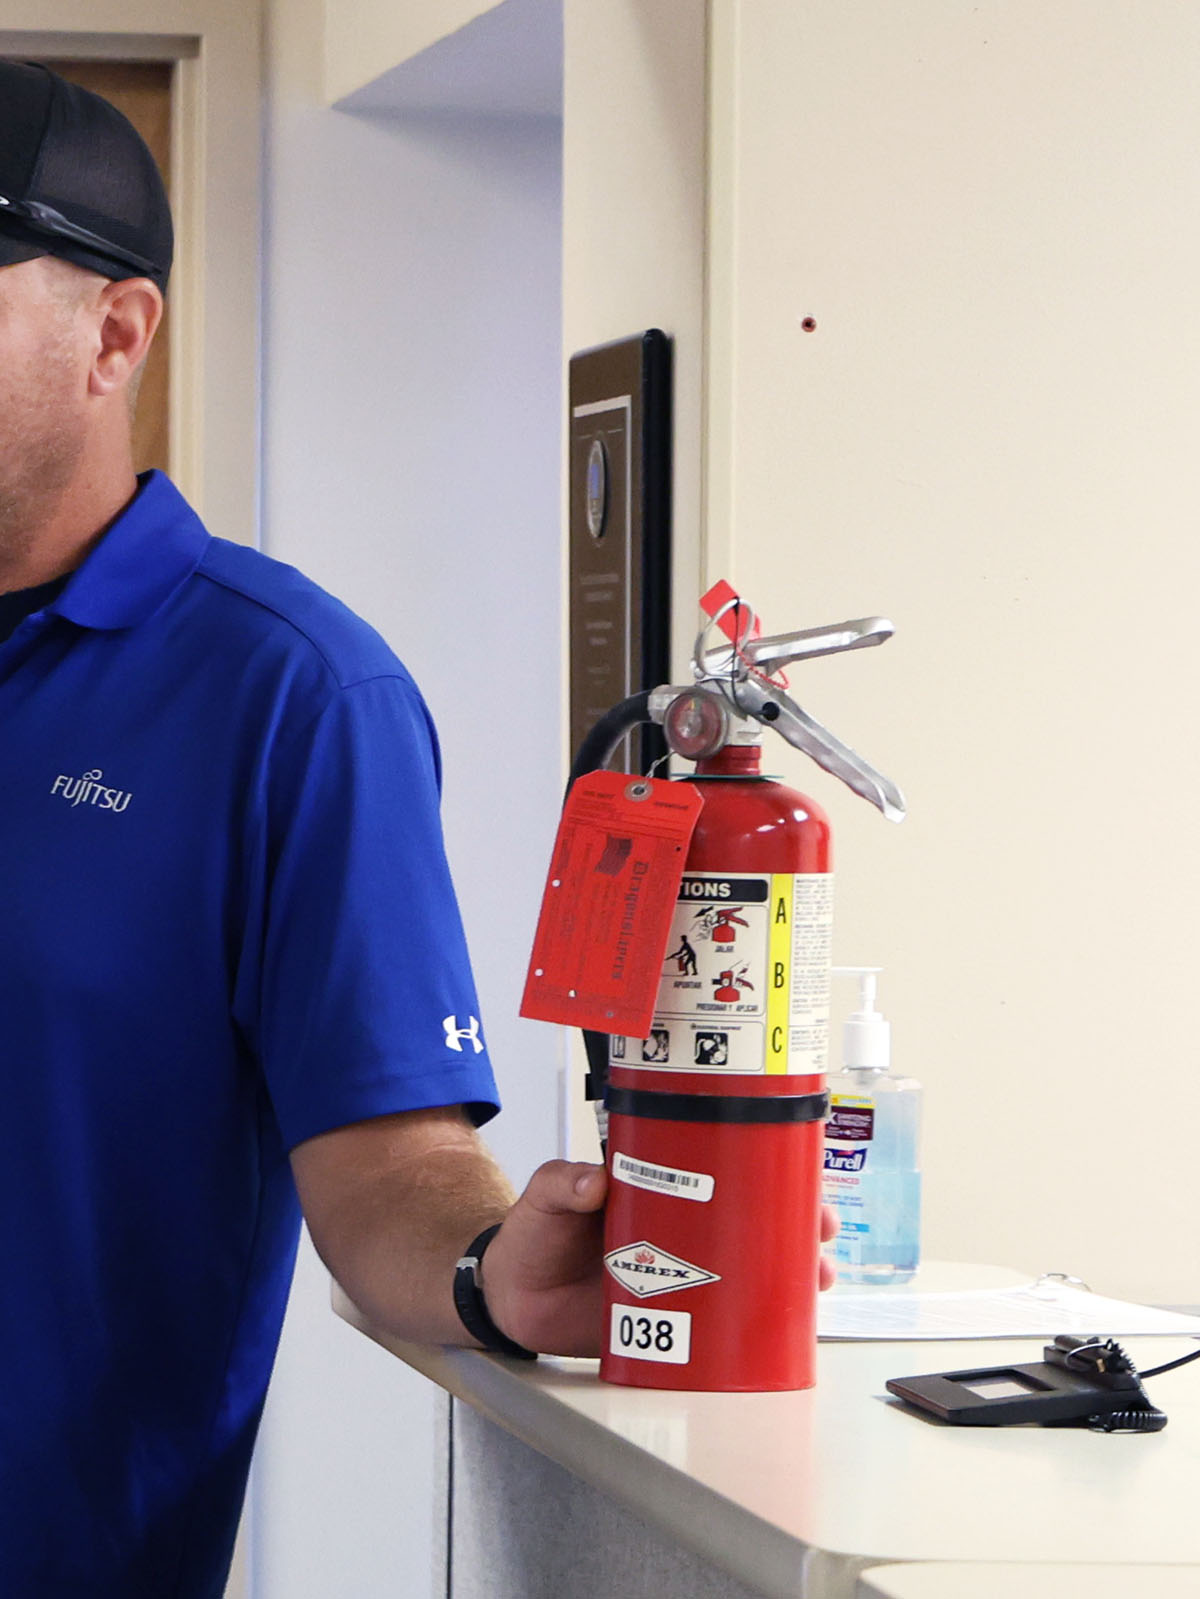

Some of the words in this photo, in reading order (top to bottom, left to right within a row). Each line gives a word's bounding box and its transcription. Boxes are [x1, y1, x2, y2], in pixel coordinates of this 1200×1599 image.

[50, 772, 133, 813] FUJITSU
[775, 897, 787, 924] A
[774, 962, 785, 989] B
[771, 1026, 783, 1053] C
[824, 1150, 863, 1170] Purell
[612, 1259, 691, 1279] AMEREX
[620, 1314, 674, 1352] 038
